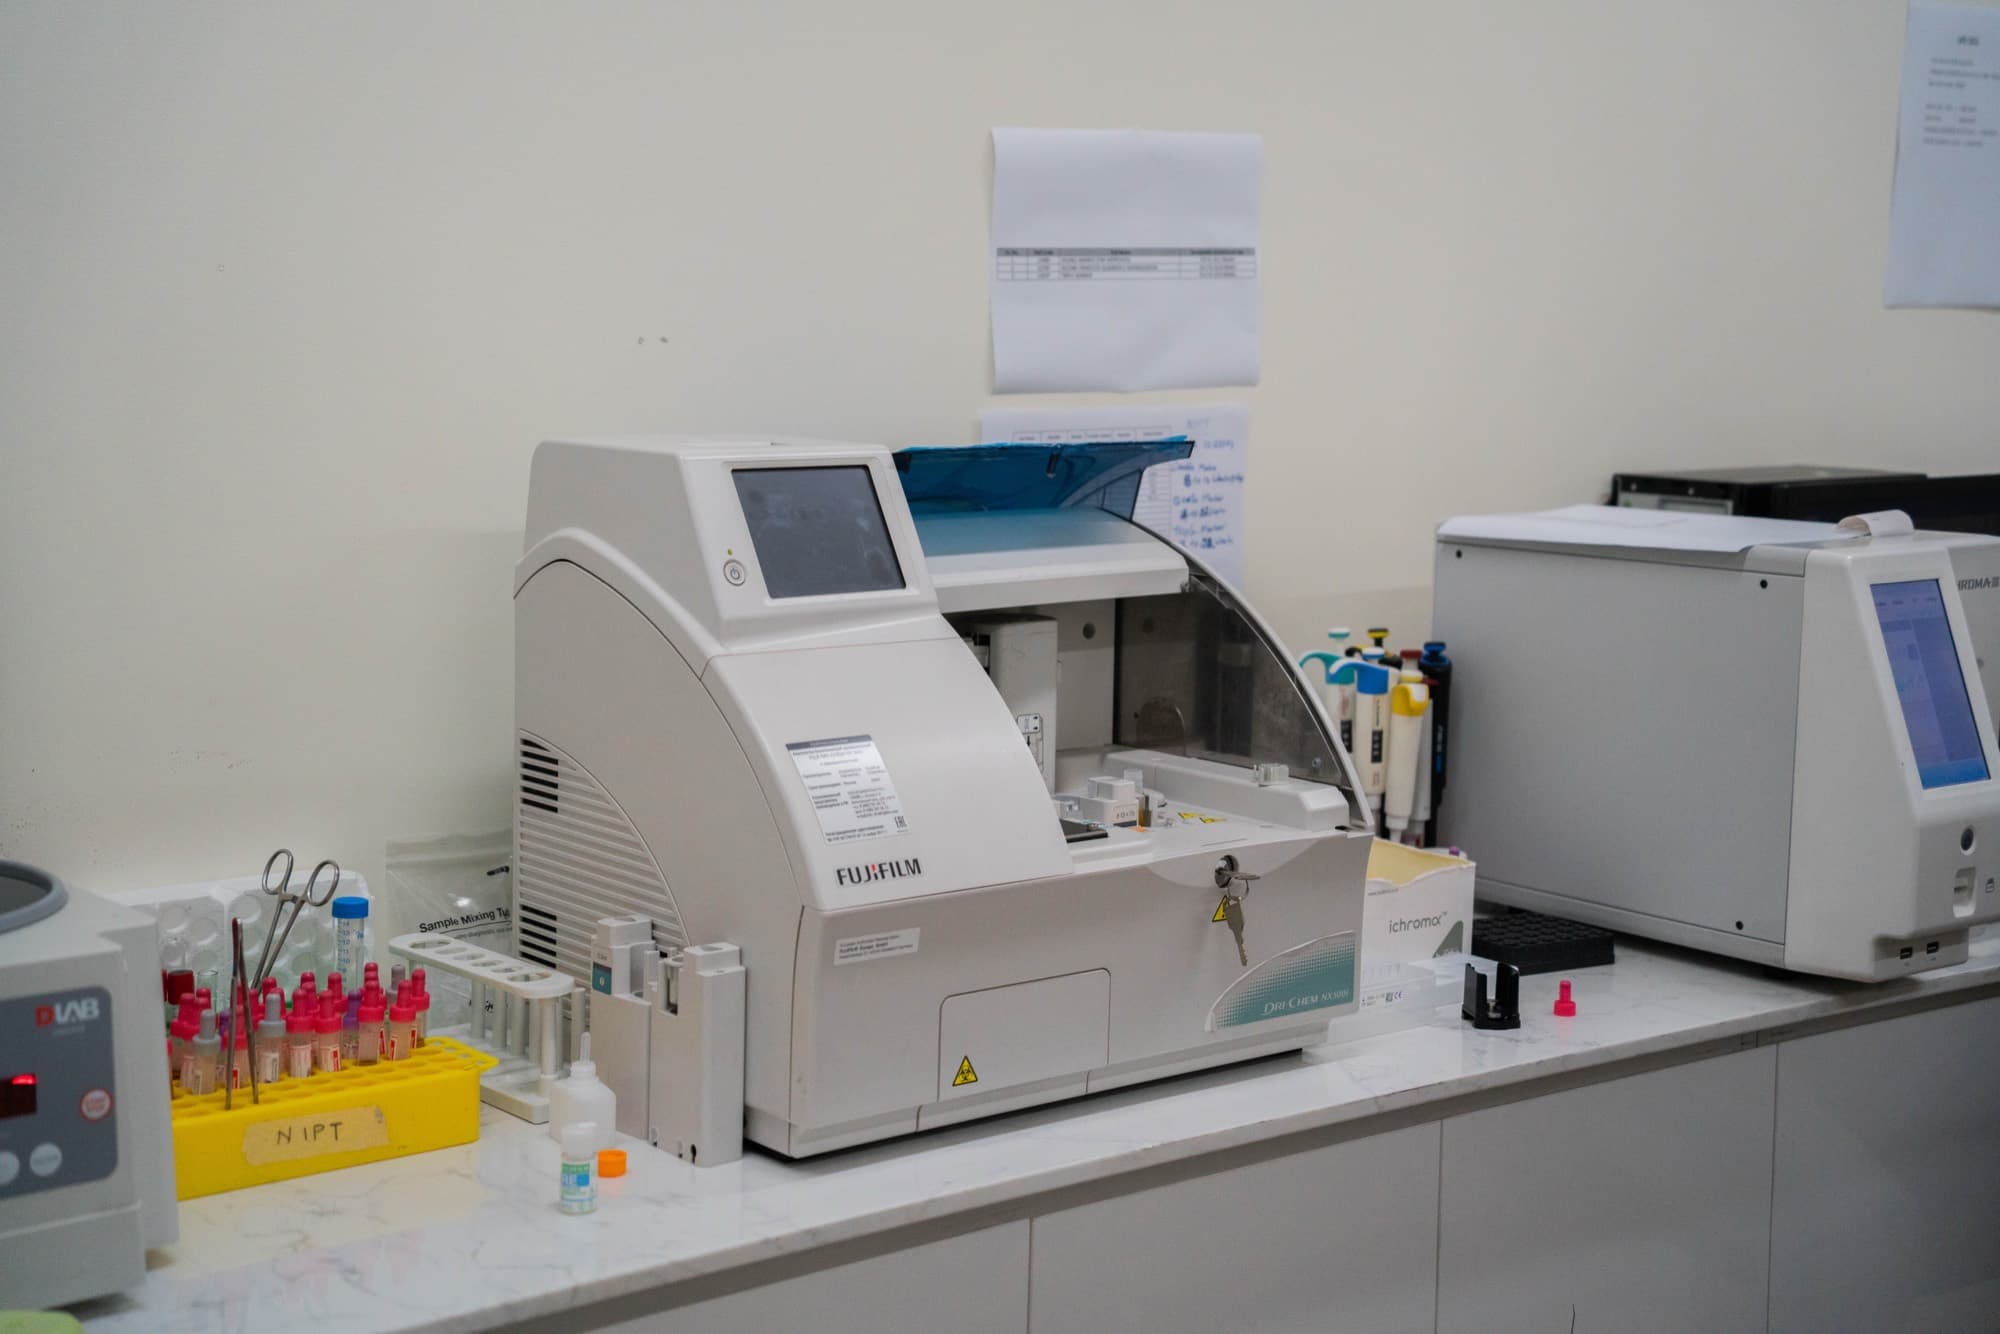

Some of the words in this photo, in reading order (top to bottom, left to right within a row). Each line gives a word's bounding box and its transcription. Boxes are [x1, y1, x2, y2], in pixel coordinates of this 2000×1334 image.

[836, 857, 922, 886] FUJIFILM
[419, 916, 459, 934] Sample
[460, 908, 496, 925] Mixing
[35, 997, 100, 1028] DLAB
